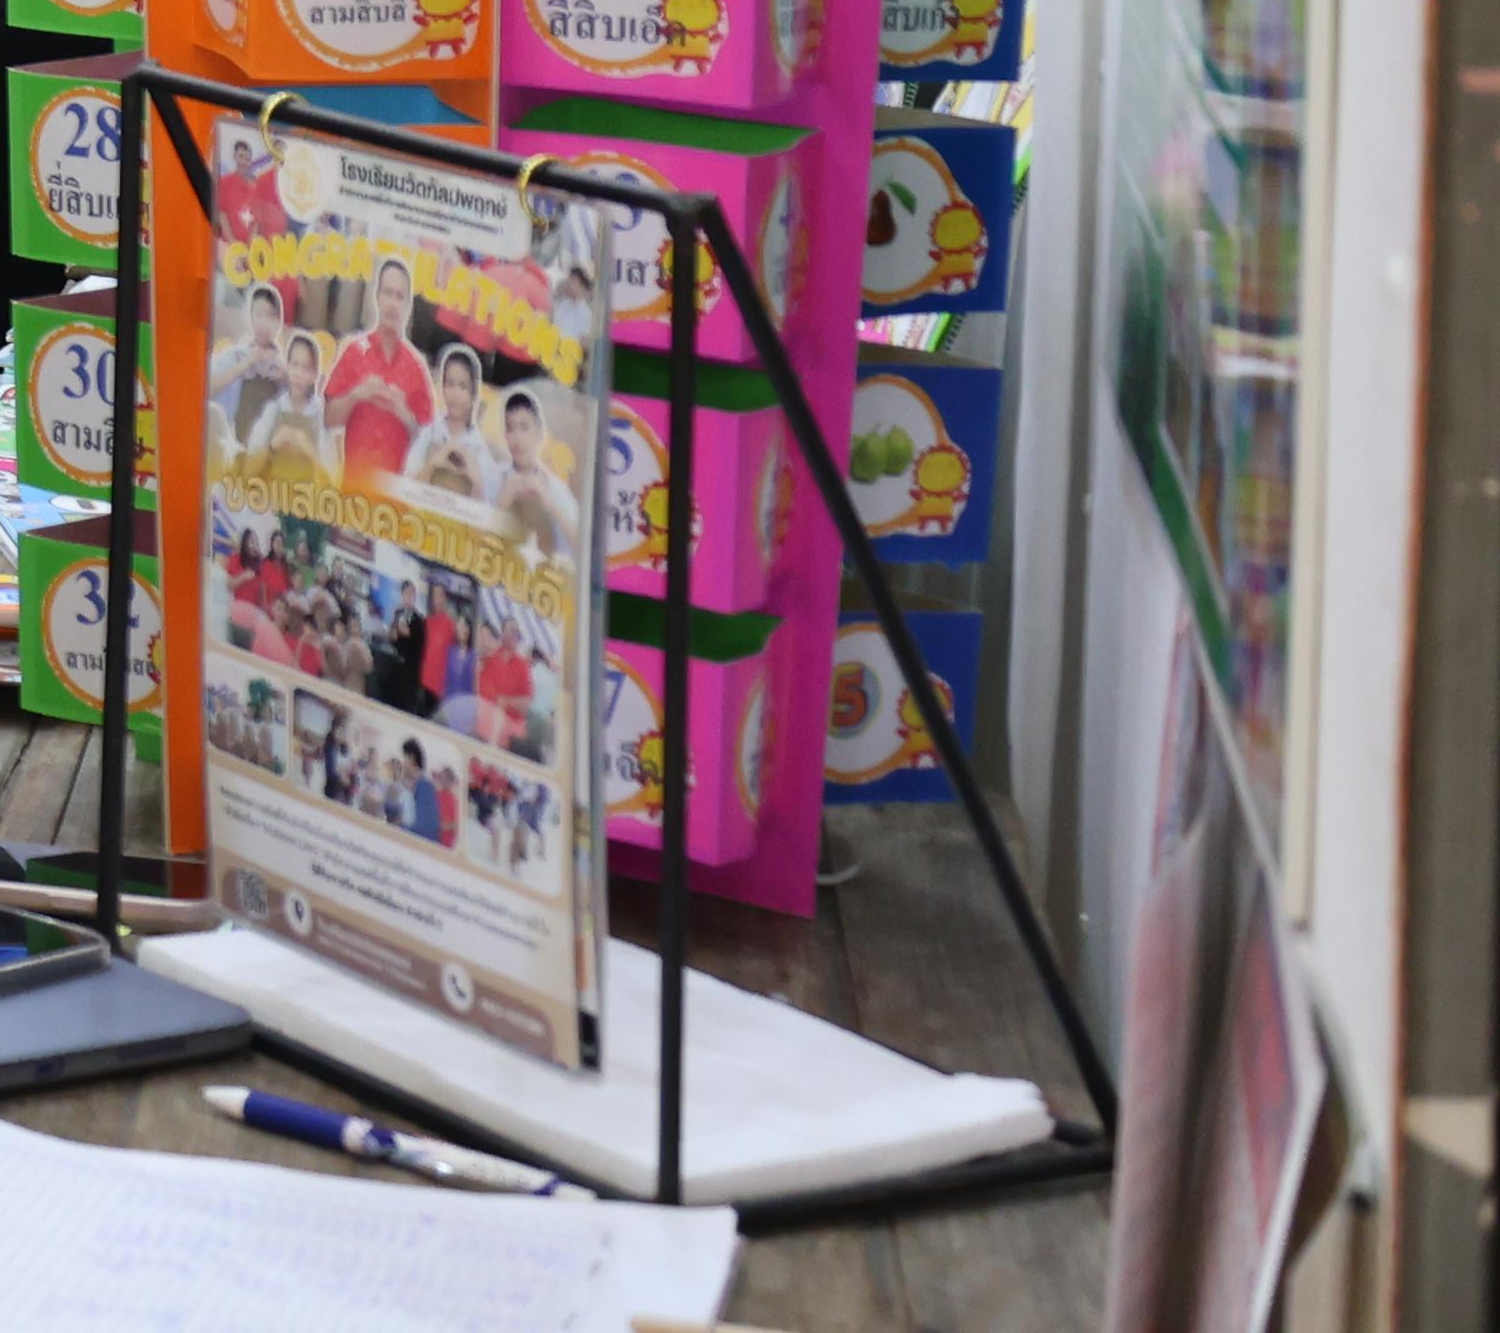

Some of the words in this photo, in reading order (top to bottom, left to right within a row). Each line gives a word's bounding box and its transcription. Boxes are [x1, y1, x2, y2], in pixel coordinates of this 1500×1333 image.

[65, 102, 121, 161] 28
[339, 155, 508, 221] โรงเรียนวัดกัลปพฤกษ์
[222, 471, 570, 625] ขอแสดงความยินดี
